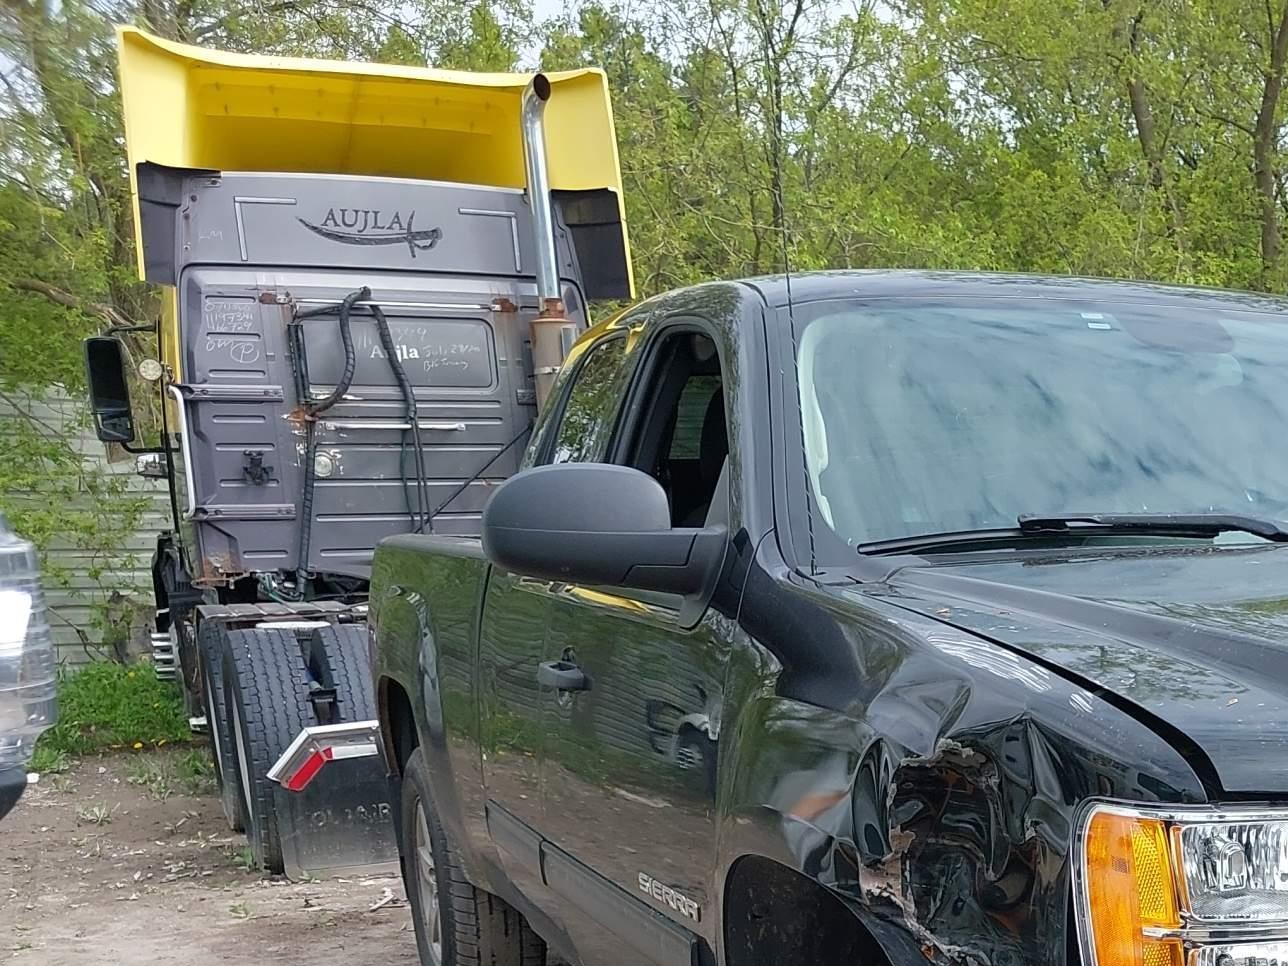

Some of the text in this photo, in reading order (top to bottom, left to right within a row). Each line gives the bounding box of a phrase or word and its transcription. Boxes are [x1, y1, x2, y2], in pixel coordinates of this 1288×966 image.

[321, 207, 407, 233] AUJLA
[370, 344, 419, 363] Ajla
[638, 871, 701, 923] SIERRA
